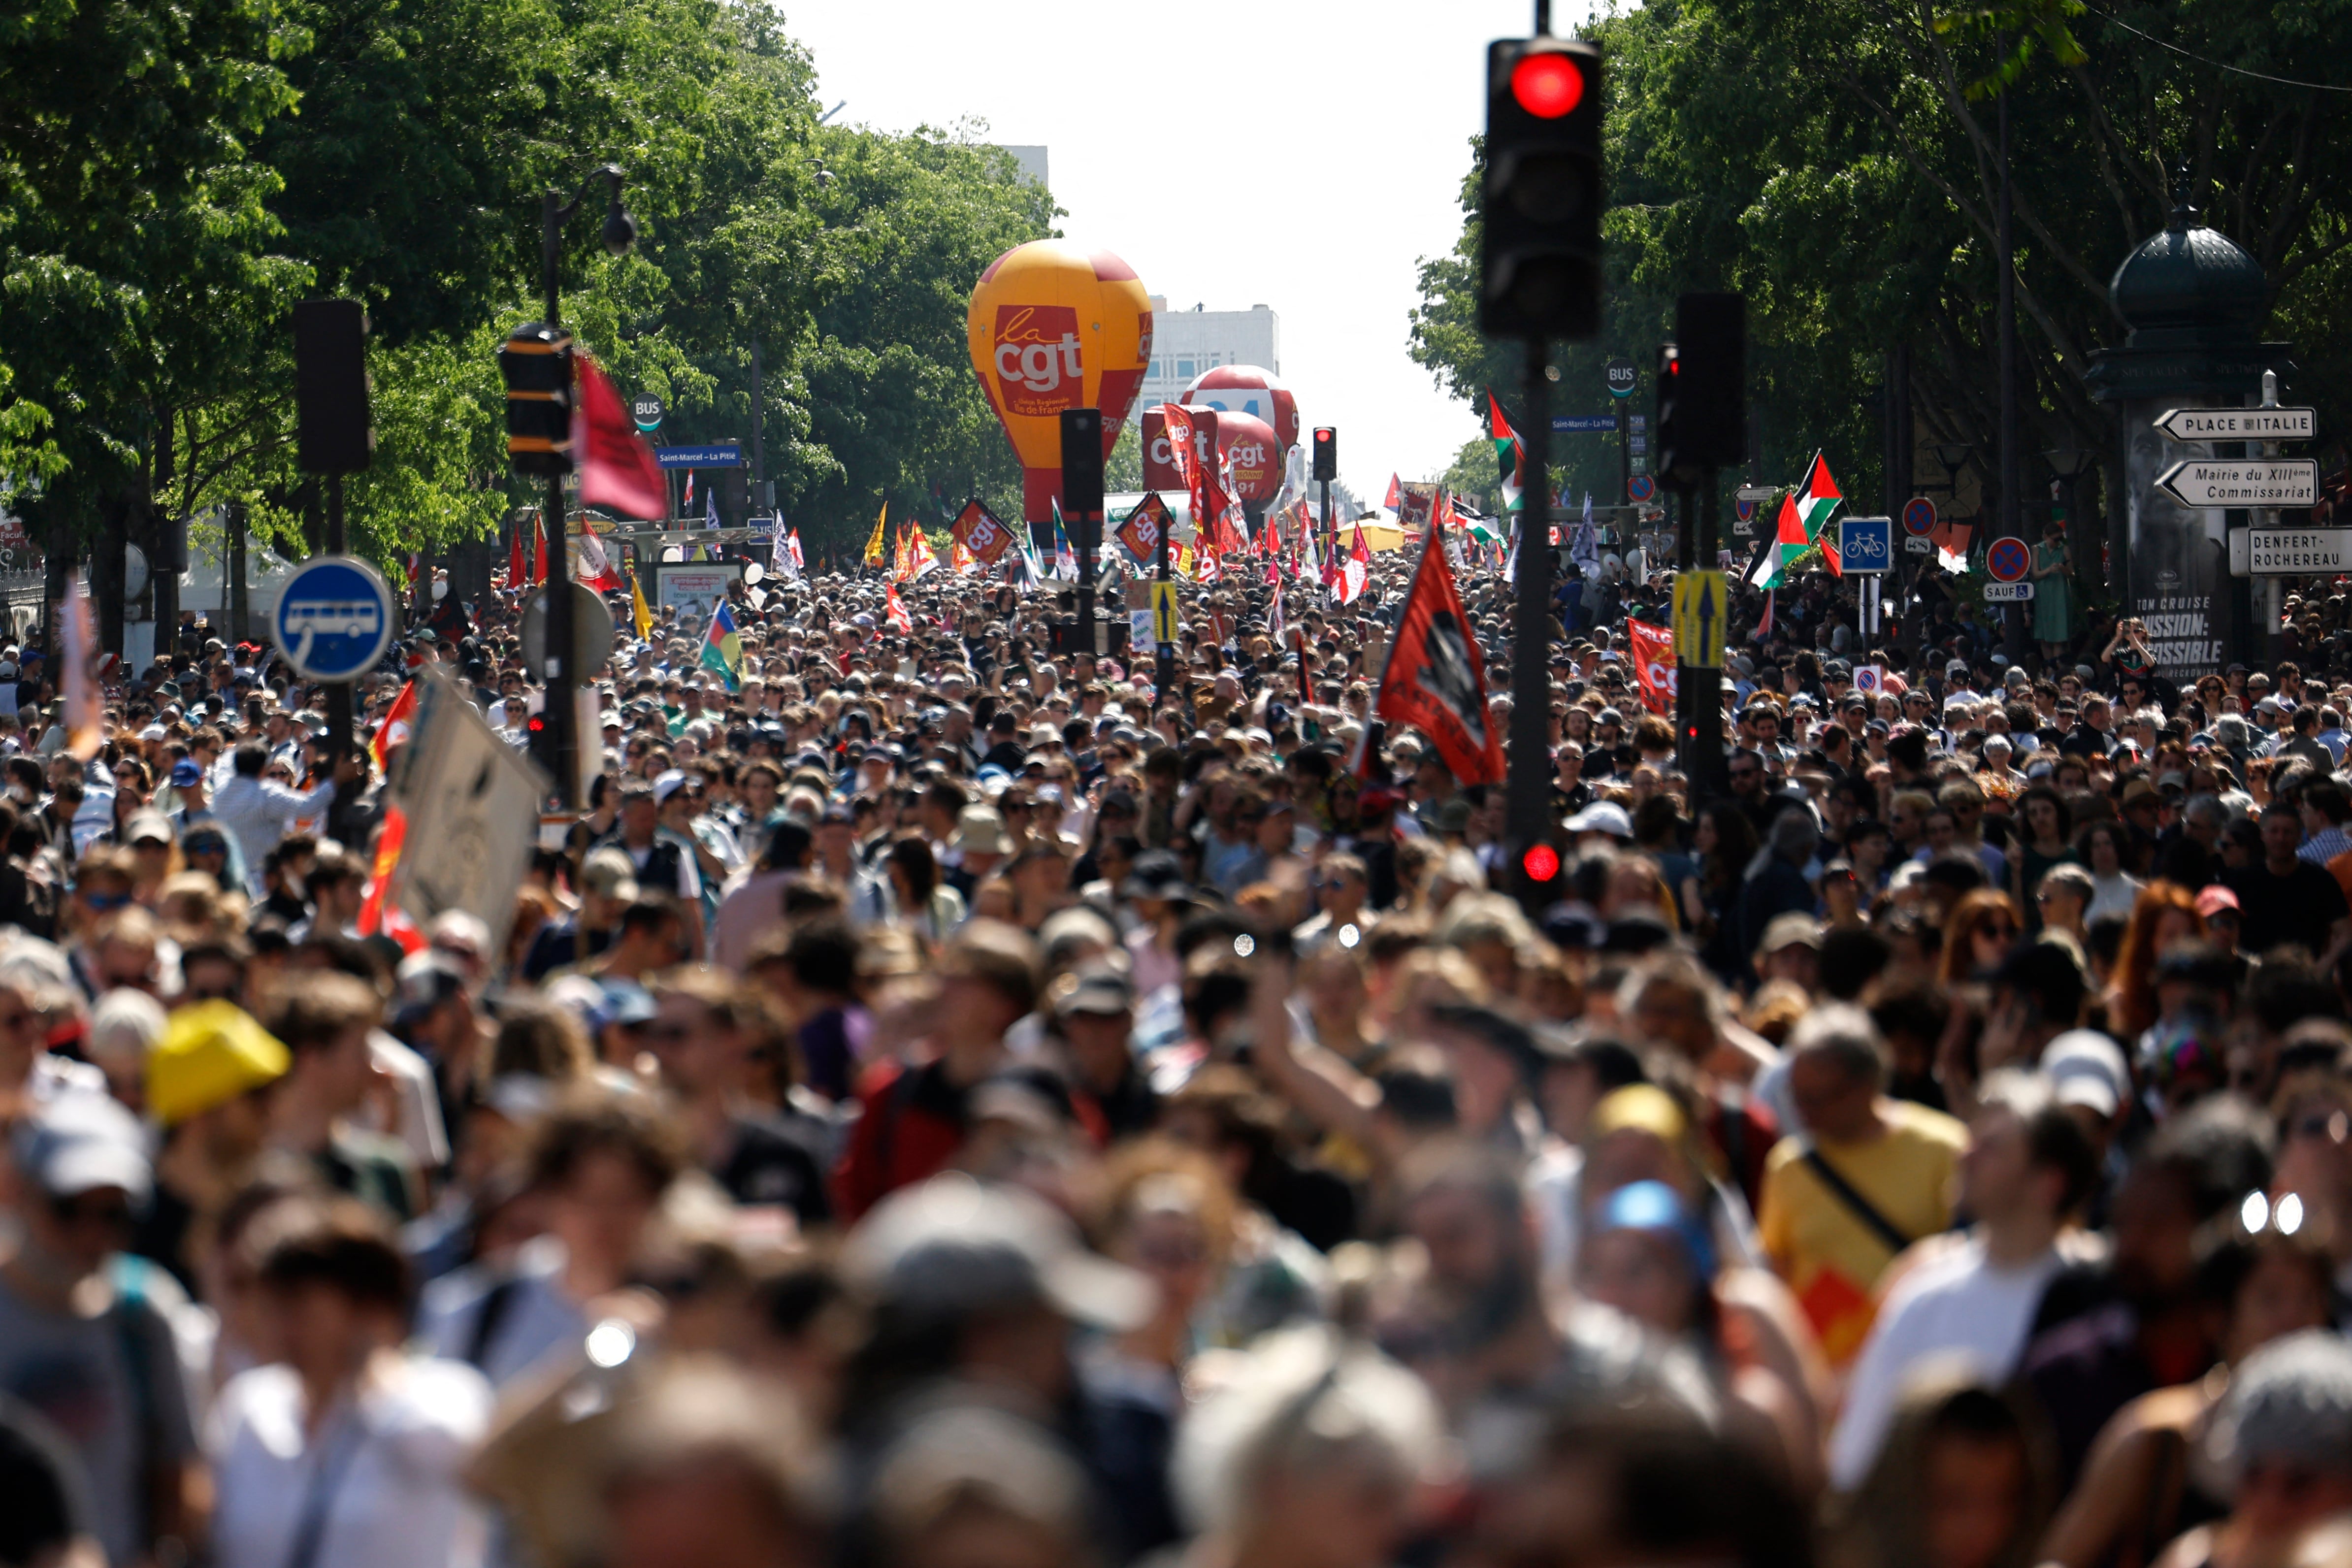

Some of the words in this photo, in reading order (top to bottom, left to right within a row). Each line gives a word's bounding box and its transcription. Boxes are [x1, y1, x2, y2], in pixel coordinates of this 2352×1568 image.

[996, 307, 1059, 343] la
[995, 332, 1082, 392] cgt
[1609, 367, 1633, 380] BUS
[2121, 366, 2187, 378] SPECTACLES
[635, 402, 660, 415] BUS
[1553, 420, 1588, 428] Saint-Marcel
[2185, 419, 2236, 431] PLACE
[659, 453, 703, 462] Saint-Marcel
[719, 452, 736, 460] Pitié
[1228, 442, 1266, 467] cgt
[2196, 468, 2239, 481] Mairie
[2246, 468, 2262, 481] du
[1238, 482, 1255, 493] 91
[2207, 486, 2312, 498] Commissariat
[967, 514, 997, 551] cgt
[2254, 536, 2324, 548] DENFERT-
[2254, 553, 2340, 566] ROCHEREAU
[1987, 588, 2015, 597] SAUF
[2137, 598, 2155, 611] TOM
[2160, 597, 2210, 609] CRUISE
